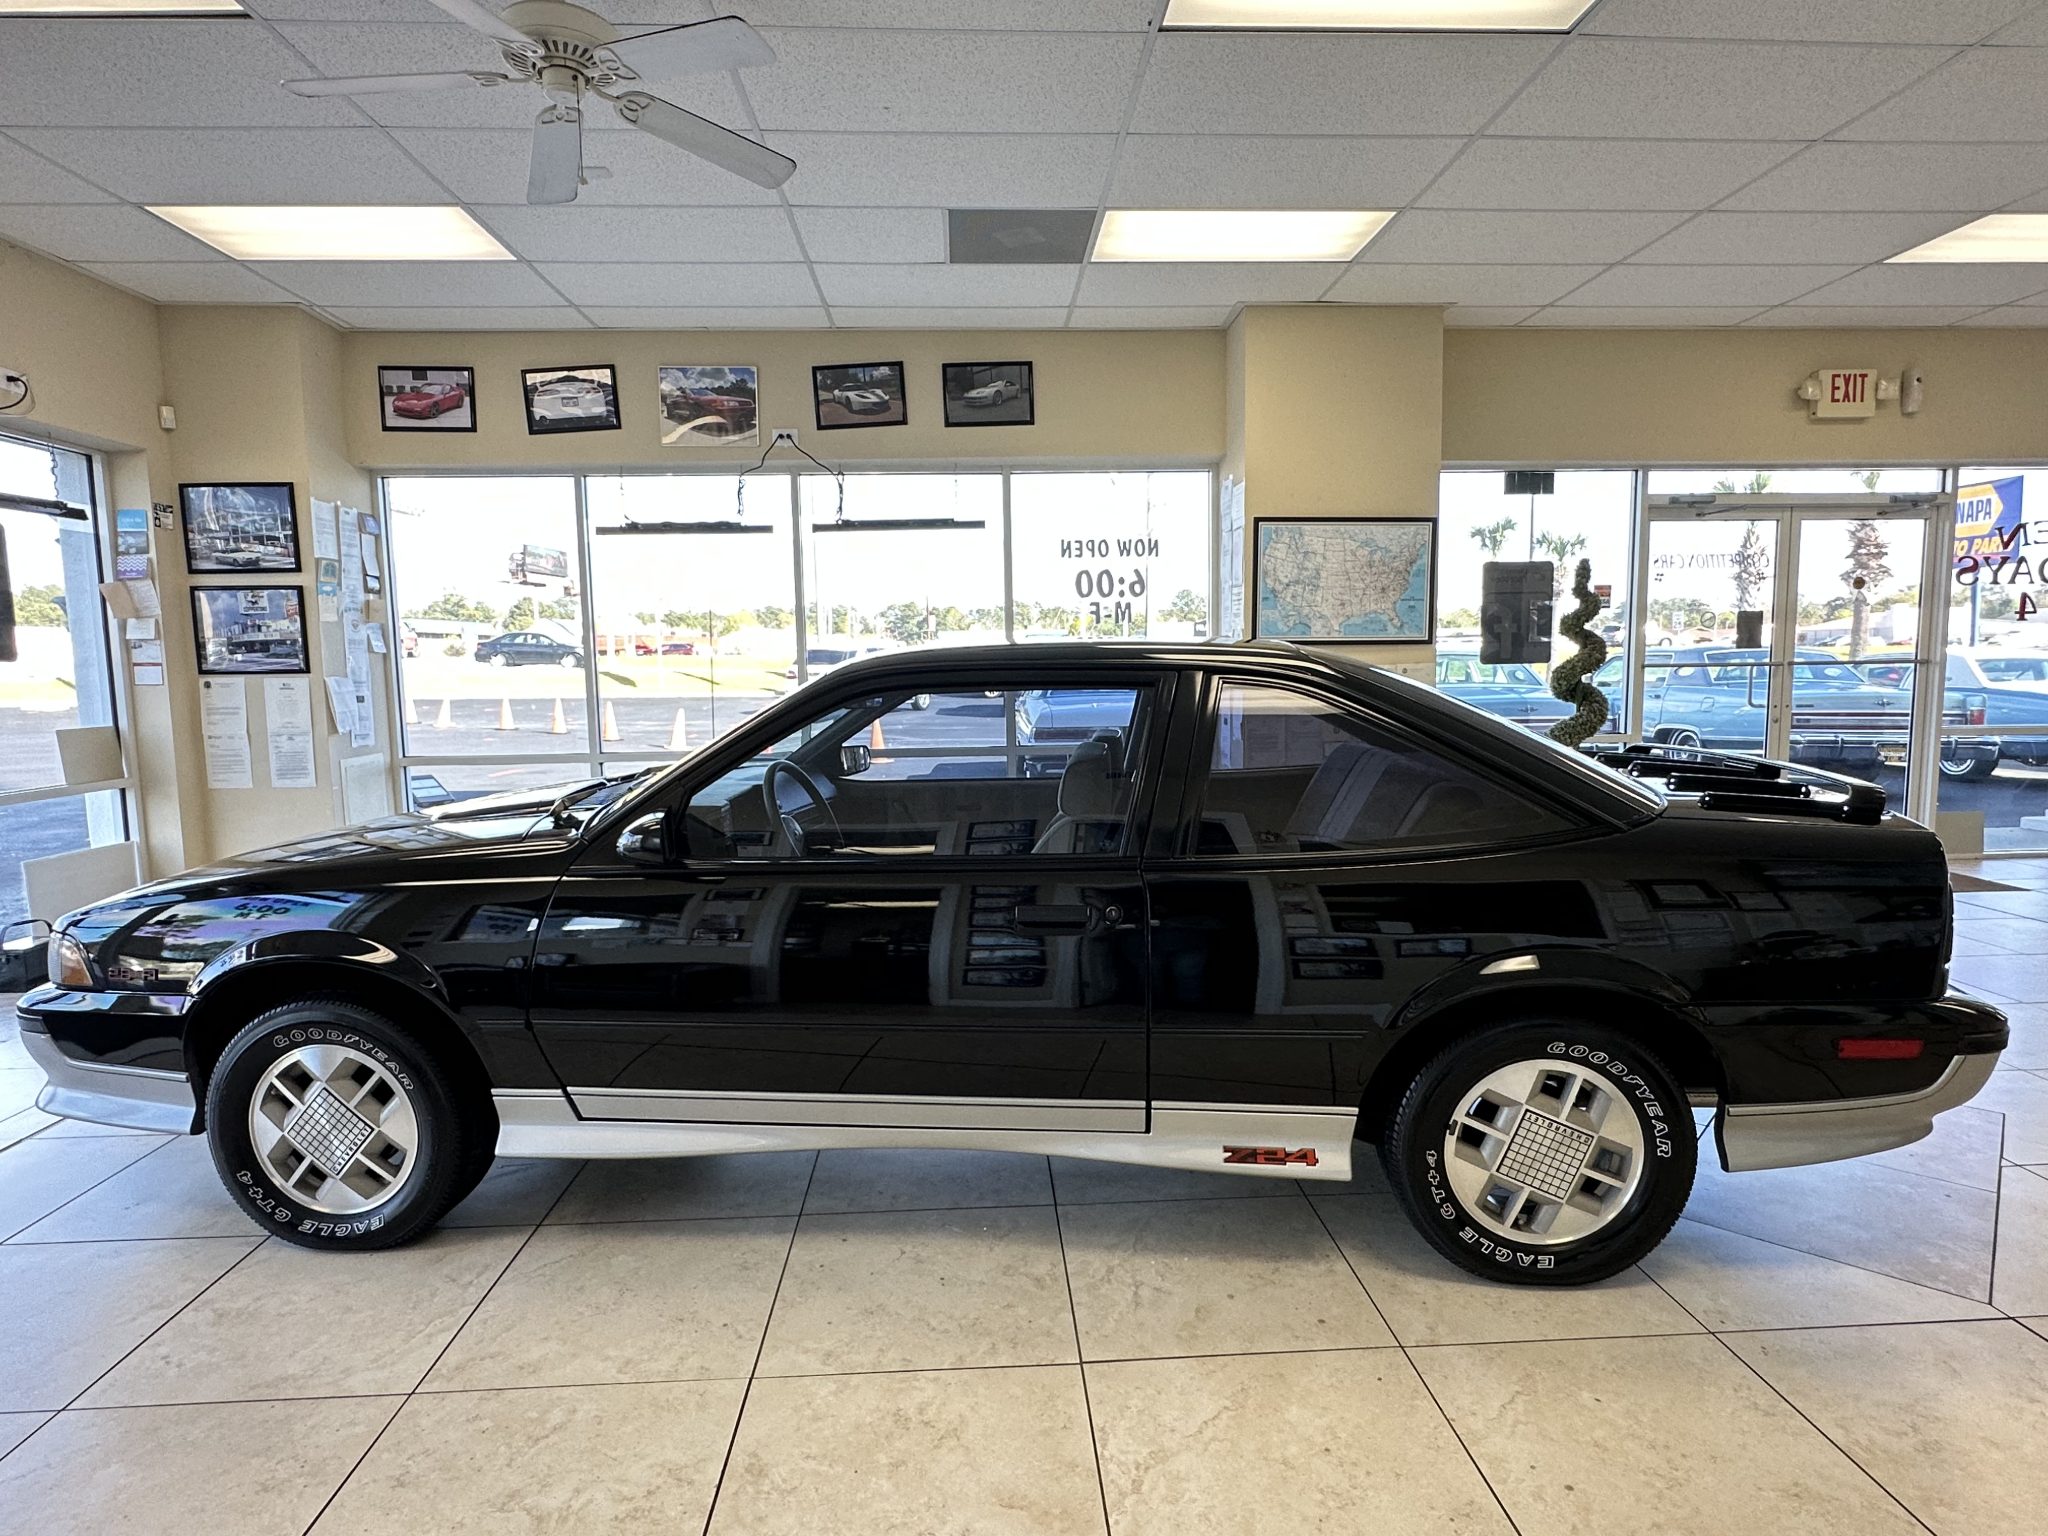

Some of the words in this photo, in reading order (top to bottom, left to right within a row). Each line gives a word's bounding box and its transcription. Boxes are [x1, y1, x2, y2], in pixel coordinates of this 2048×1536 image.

[1831, 373, 1868, 403] EXIT
[1956, 498, 1992, 524] NAPA
[273, 1027, 414, 1090] GOODYEAR
[1547, 1041, 1672, 1158] GOODYEAR
[332, 1126, 369, 1172] CHEVROLET
[1522, 1114, 1590, 1143] CHEVROLET
[1223, 1146, 1319, 1166] Z24
[237, 1170, 291, 1223] GT+4
[1426, 1150, 1456, 1220] GT+4
[298, 1213, 385, 1236] EAGLE
[1459, 1226, 1554, 1268] EAGLE
